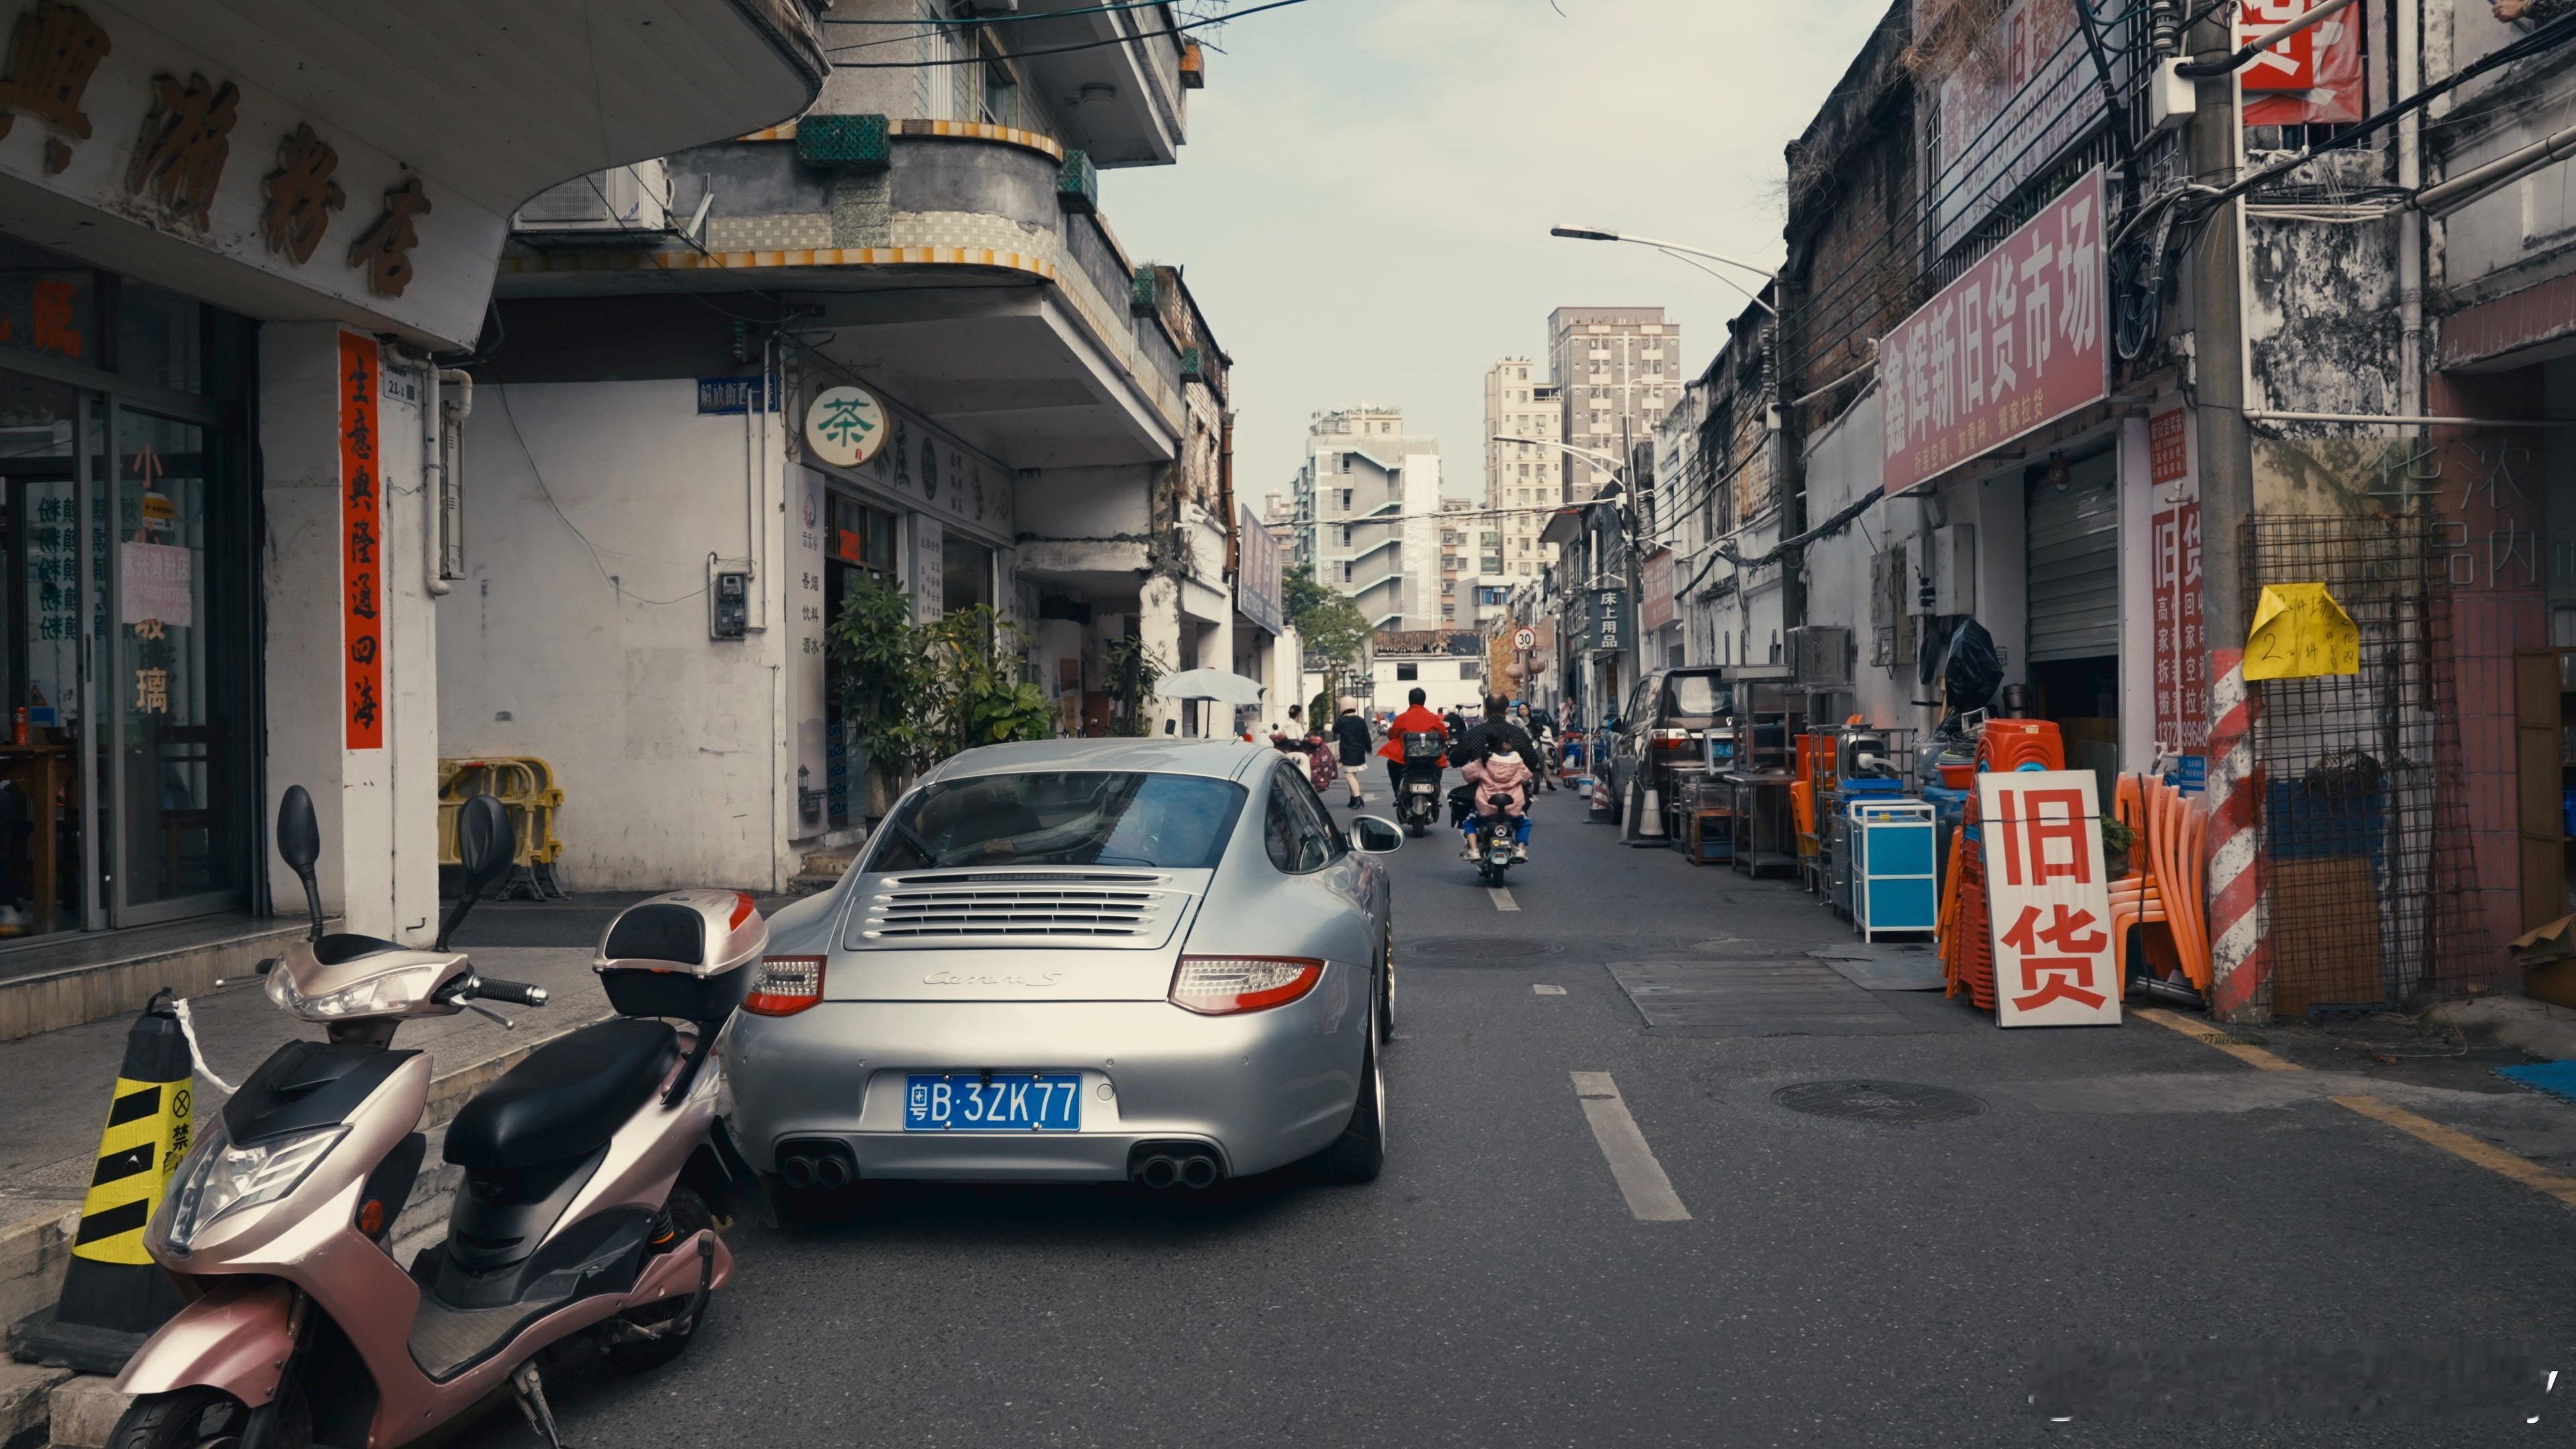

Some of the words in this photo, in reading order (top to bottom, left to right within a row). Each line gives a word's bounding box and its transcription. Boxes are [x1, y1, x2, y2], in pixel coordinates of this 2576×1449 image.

[1884, 194, 2097, 462] 鑫辉新旧货市场
[818, 398, 875, 447] 茶
[802, 572, 818, 592] 香烟
[802, 605, 818, 623] 饮料
[1601, 592, 1617, 649] 床上用品
[802, 637, 819, 655] 酒水
[1519, 633, 1531, 645] 30
[1998, 788, 2108, 1012] 旧货
[922, 971, 1028, 985] Carrera
[1026, 971, 1063, 987] S
